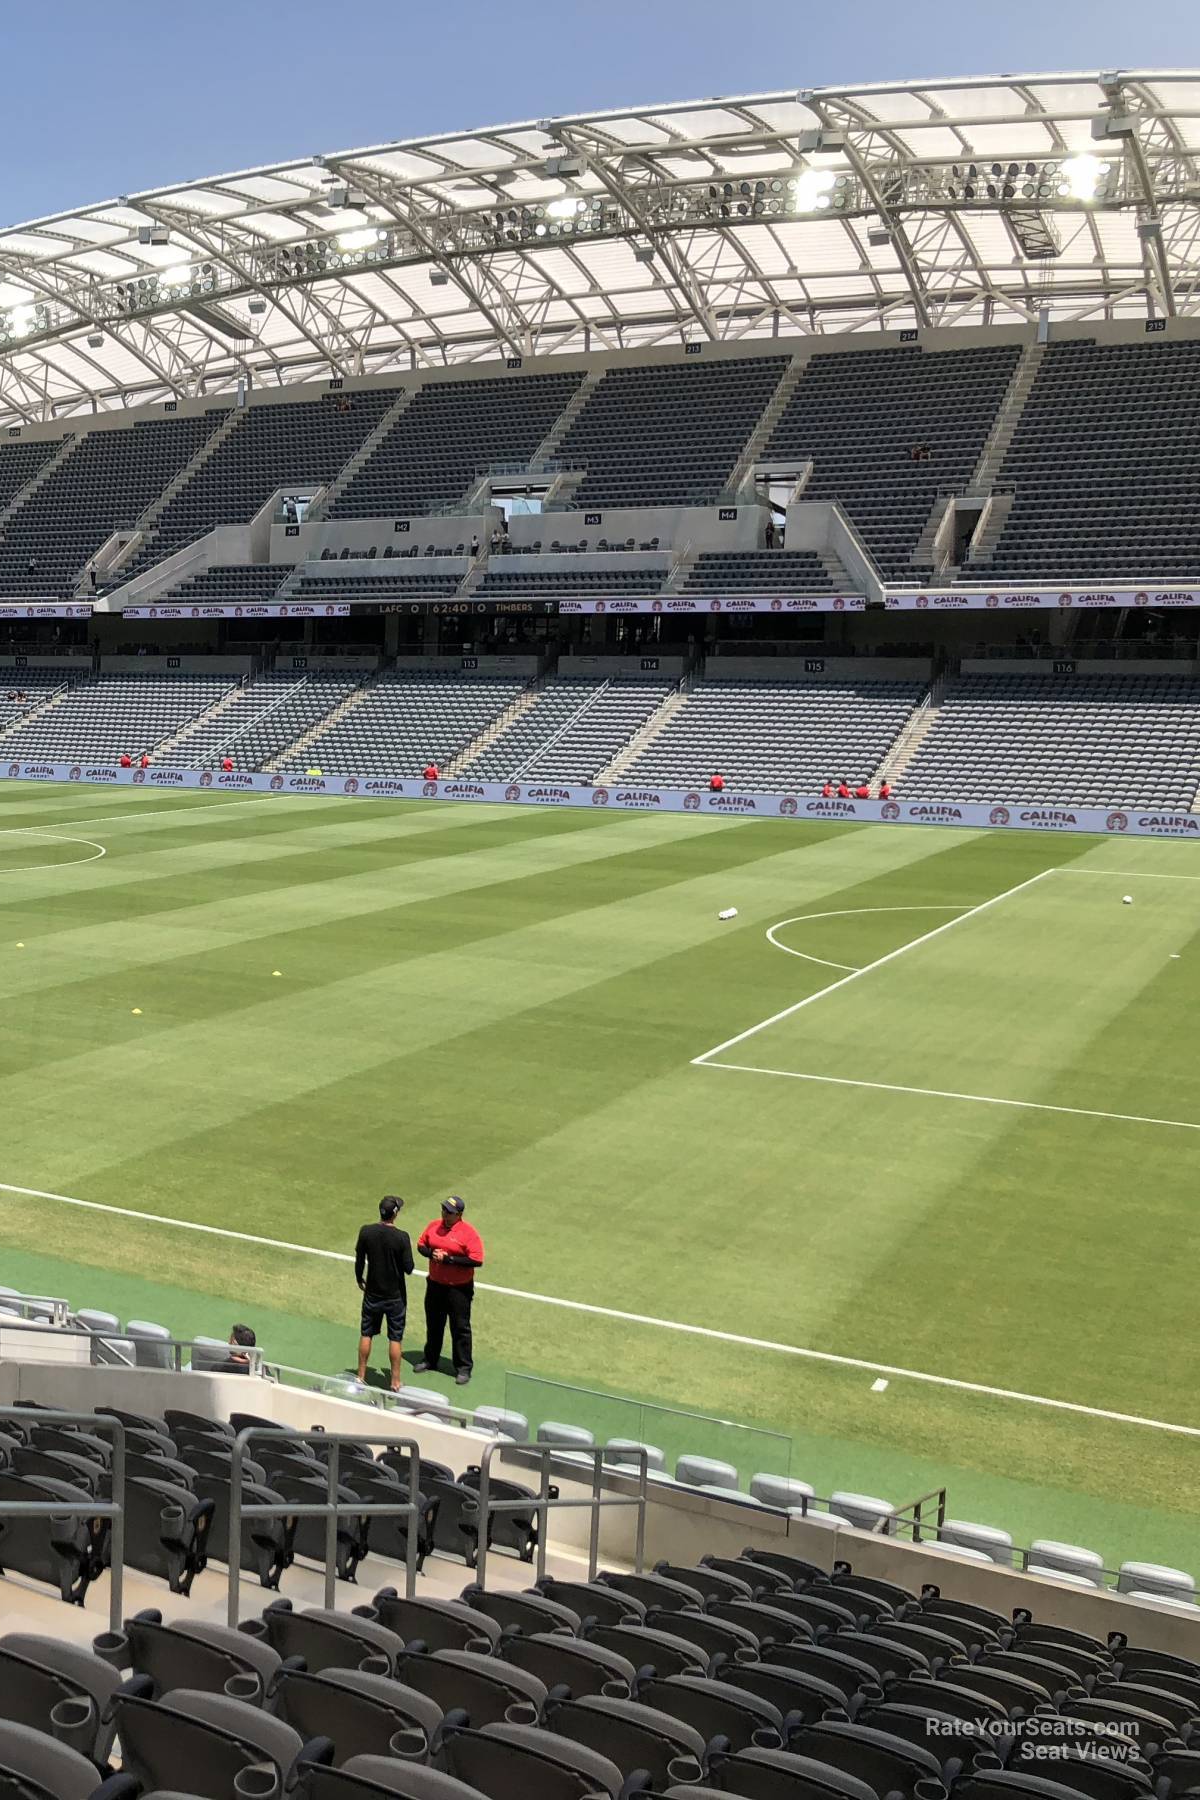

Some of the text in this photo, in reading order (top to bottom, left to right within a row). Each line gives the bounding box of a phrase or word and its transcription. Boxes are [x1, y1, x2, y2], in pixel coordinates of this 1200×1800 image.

[1148, 321, 1164, 330] 215
[902, 332, 916, 340] 214
[687, 345, 700, 353] 213
[588, 515, 599, 524] M3
[722, 510, 734, 519] M4
[934, 597, 968, 605] CALIFIA
[1004, 595, 1040, 603] CALIFIA
[1078, 594, 1116, 602] CALIFIA
[1155, 593, 1193, 601] CALIFIA
[380, 604, 402, 613] LAFC
[433, 604, 468, 613] 62:40
[807, 662, 821, 671] 115
[1057, 664, 1072, 672] 116
[24, 766, 54, 776] CALIFIA
[86, 769, 117, 779] CALIFIA
[151, 772, 183, 782] CALIFIA
[219, 774, 253, 785] CALIFIA
[290, 777, 325, 788] CALIFIA
[365, 781, 403, 792] CALIFIA
[444, 784, 484, 796] CALIFIA
[528, 788, 569, 800] CALIFIA
[616, 792, 660, 803] CALIFIA
[709, 796, 756, 808] CALIFIA
[806, 801, 856, 814] CALIFIA
[910, 806, 962, 819] CALIFIA
[1020, 811, 1076, 824] CALIFIA
[1138, 817, 1198, 830] CALIFIA
